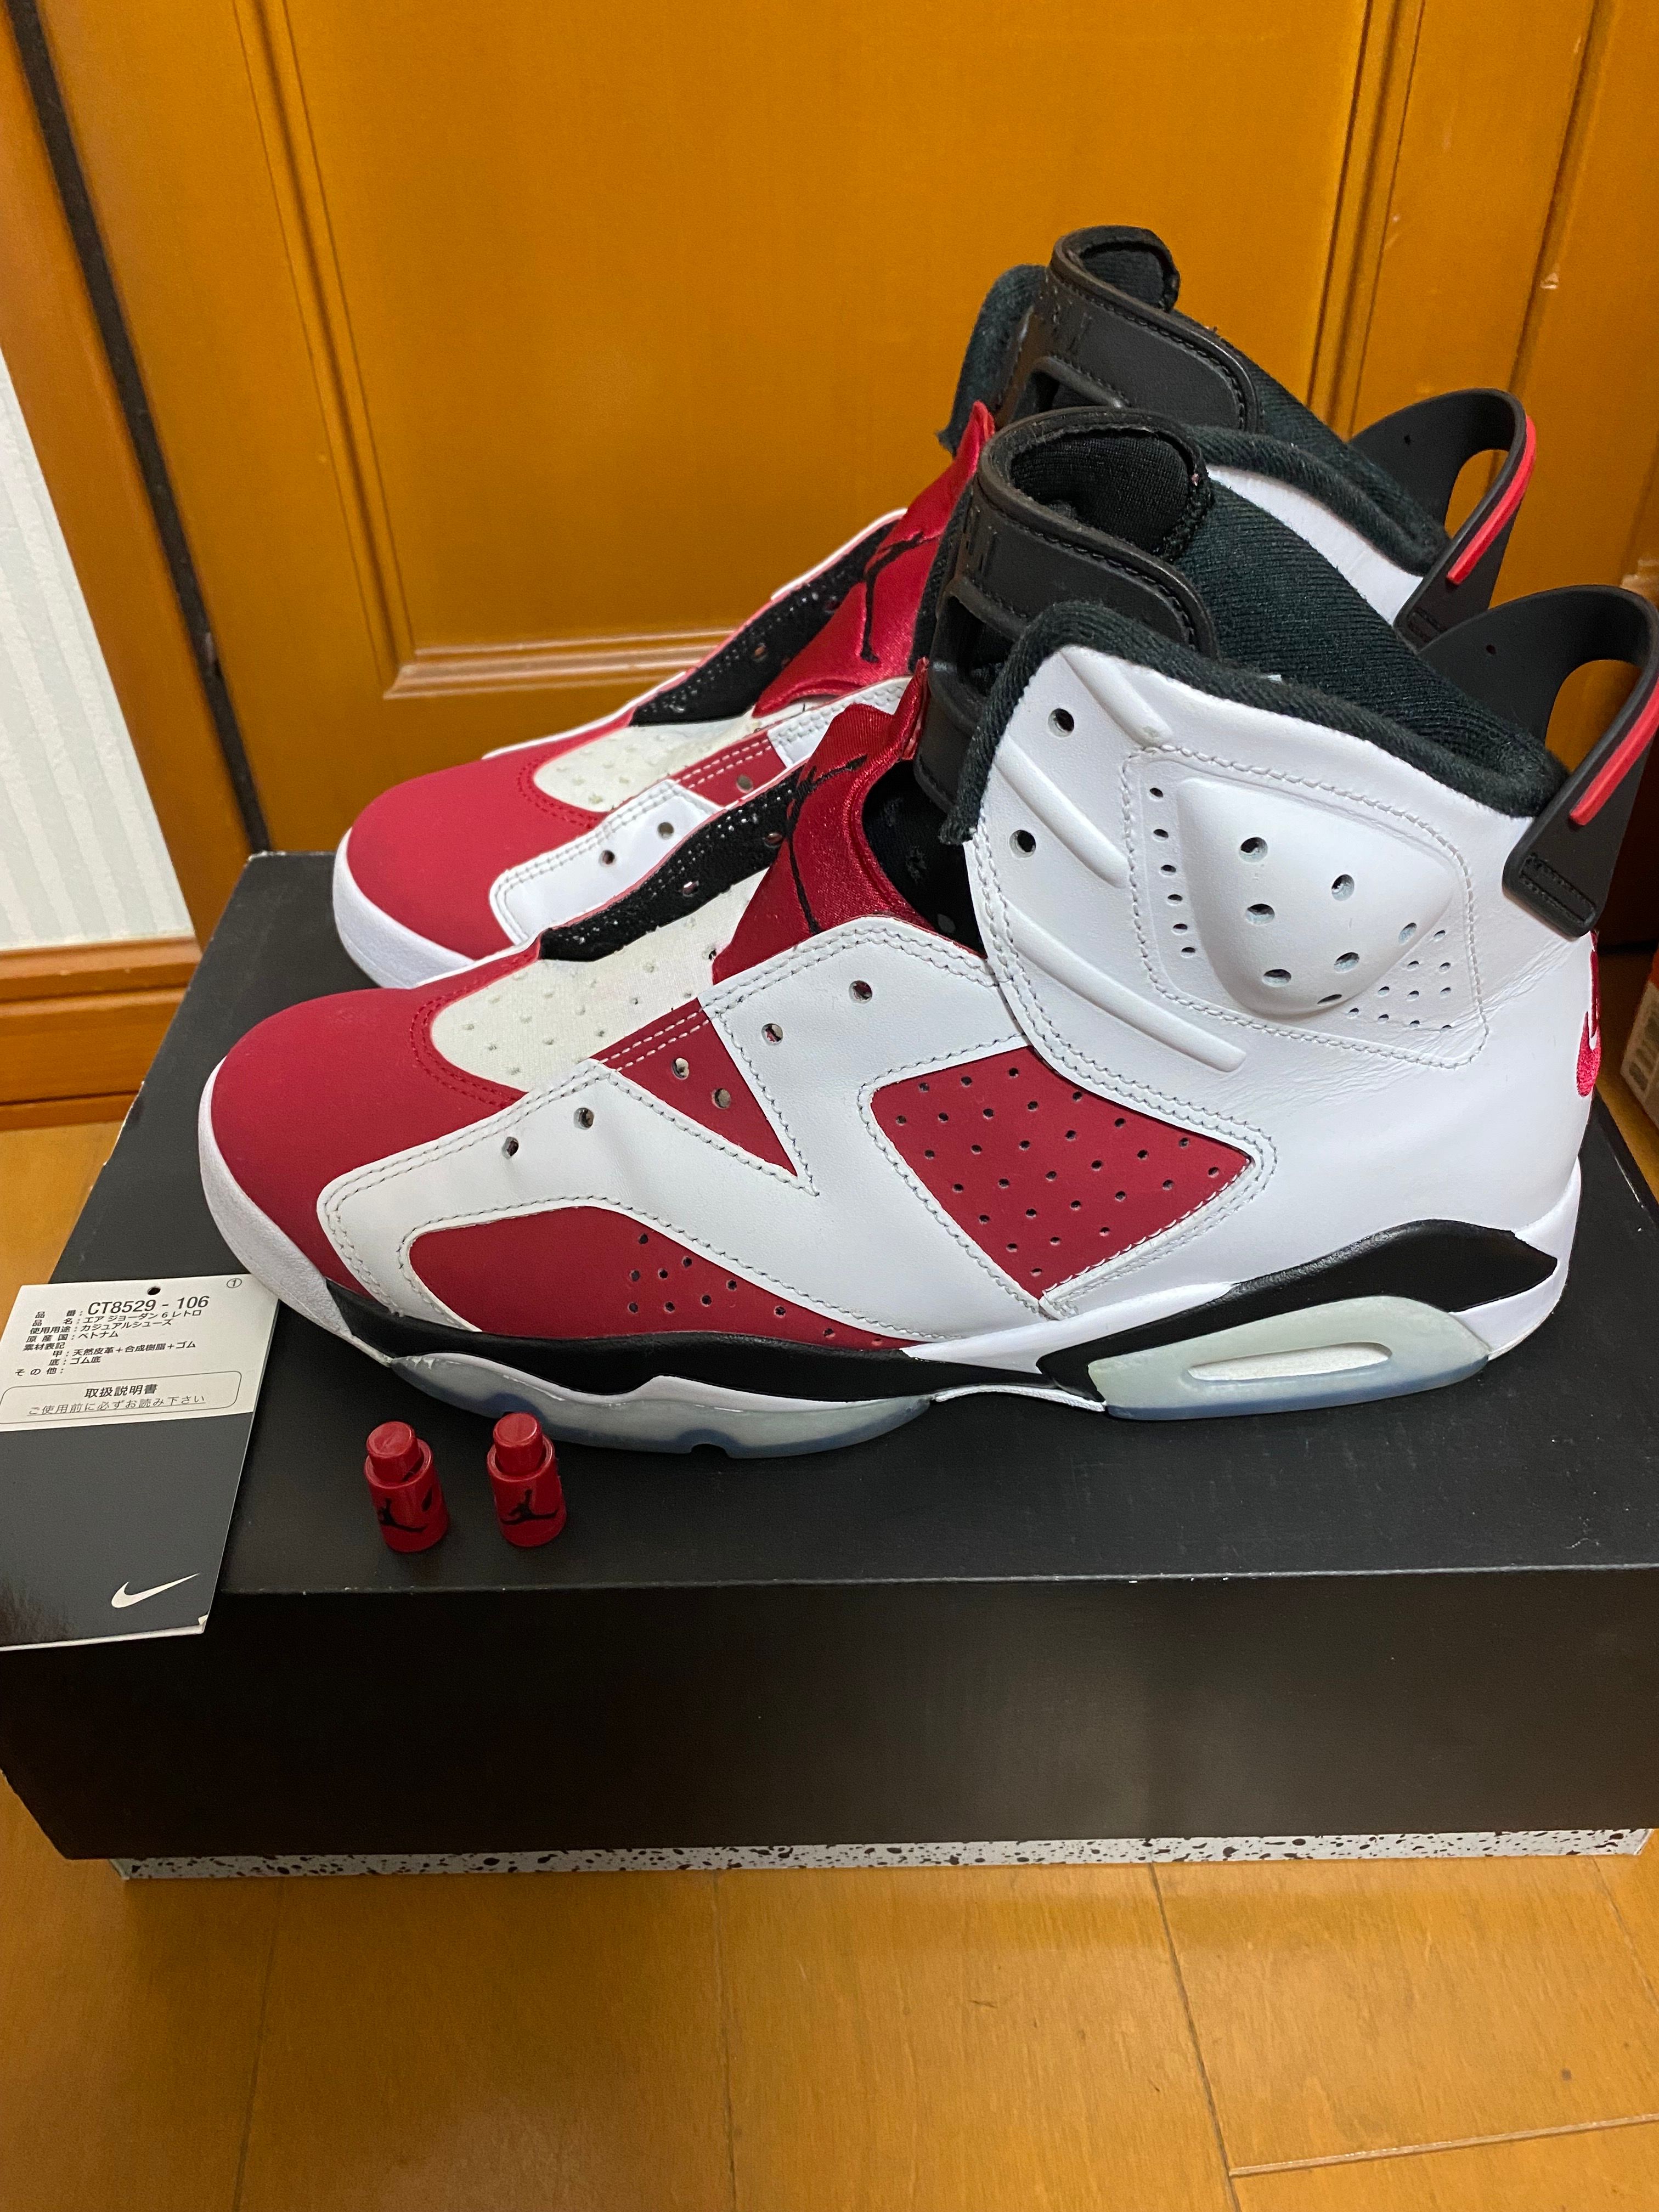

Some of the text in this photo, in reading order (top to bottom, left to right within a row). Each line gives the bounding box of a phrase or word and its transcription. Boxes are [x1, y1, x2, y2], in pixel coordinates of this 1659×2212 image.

[87, 1300, 157, 1316] CT8529
[177, 1295, 210, 1309] 106
[84, 1384, 159, 1398] 取扱説明書
[29, 1395, 206, 1415] ご使用前に必ずお読み下さい
